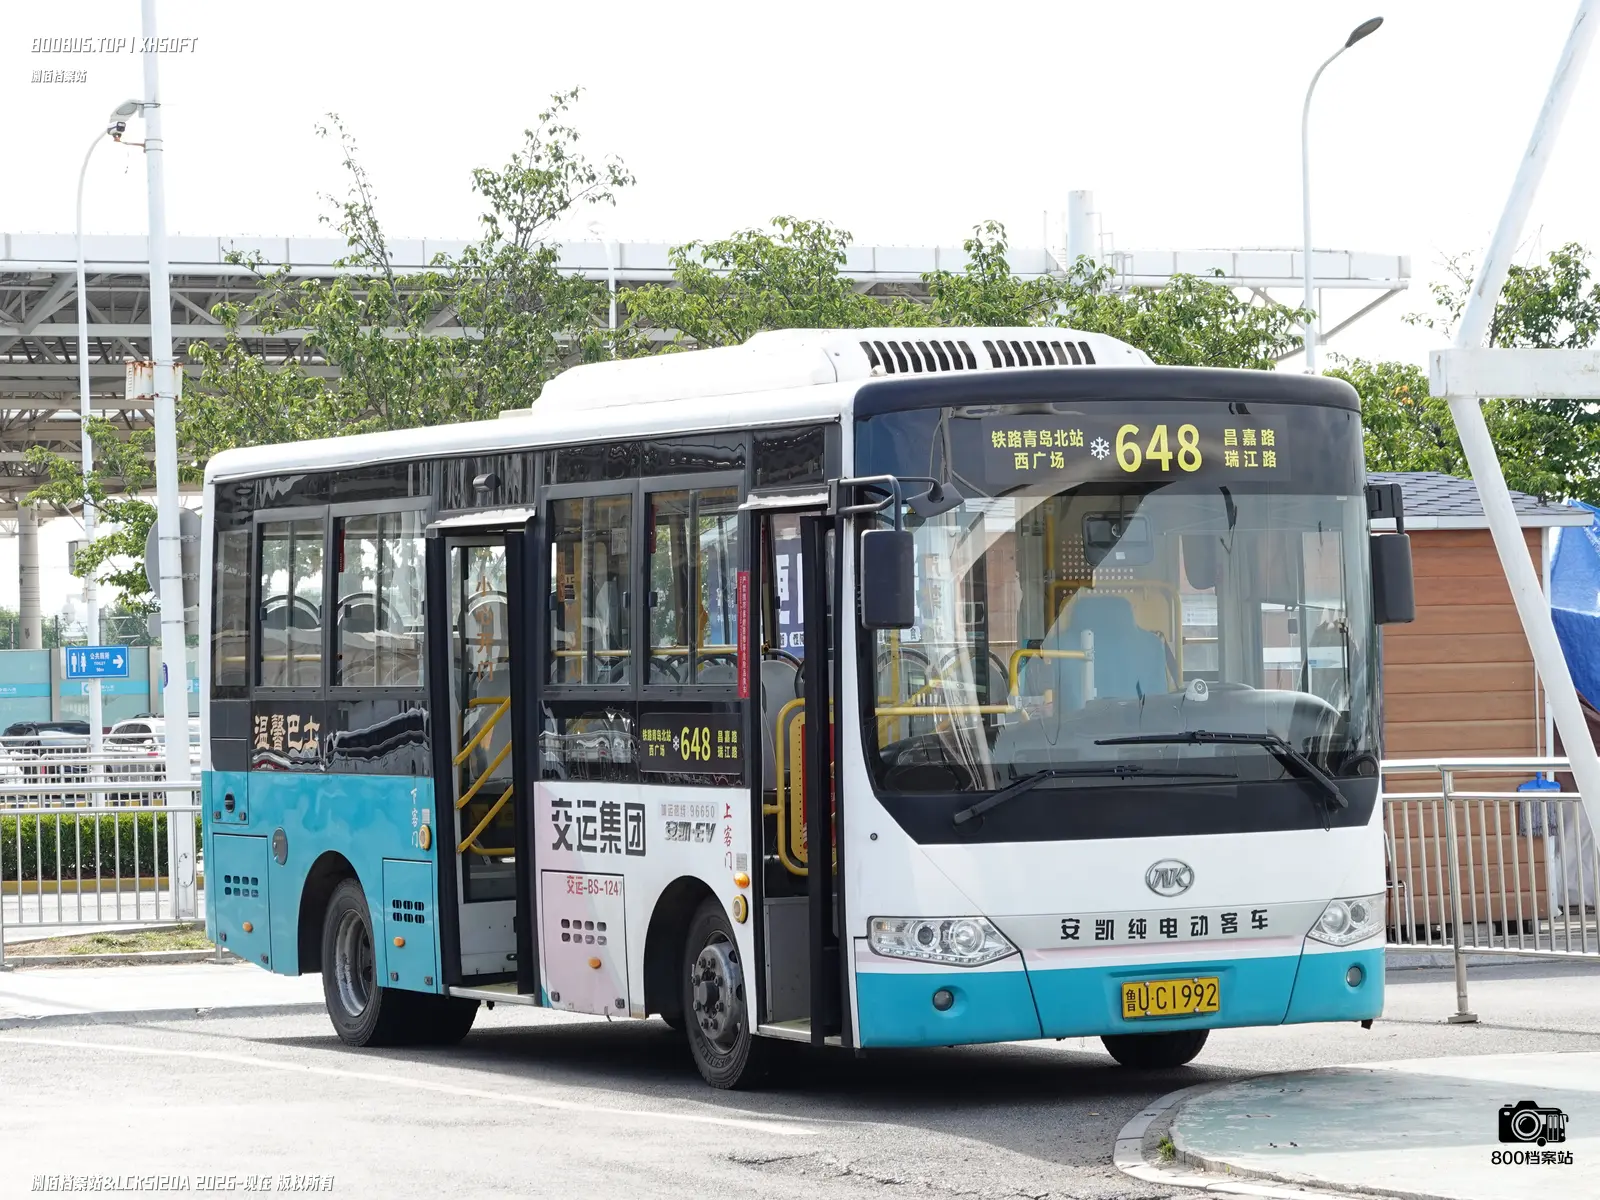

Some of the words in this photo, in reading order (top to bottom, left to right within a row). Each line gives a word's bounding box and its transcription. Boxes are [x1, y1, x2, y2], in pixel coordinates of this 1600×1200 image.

[991, 429, 1084, 449] 铁路青岛北站
[1115, 423, 1203, 473] 648
[1223, 428, 1276, 448] 昌嘉路
[1014, 451, 1065, 470] 西广场
[1224, 450, 1277, 469] 瑞江路
[254, 713, 320, 751] 温馨巴士
[642, 729, 672, 742] 铁路青岛北站
[717, 730, 738, 743] 昌嘉路
[648, 744, 665, 757] 西广场
[680, 726, 711, 761] 648
[717, 746, 738, 759] 瑞江路
[409, 787, 419, 849] 下客门
[551, 798, 646, 857] 交运集团
[723, 802, 733, 871] 上客门
[1060, 908, 1269, 941] 安凯纯电动客车
